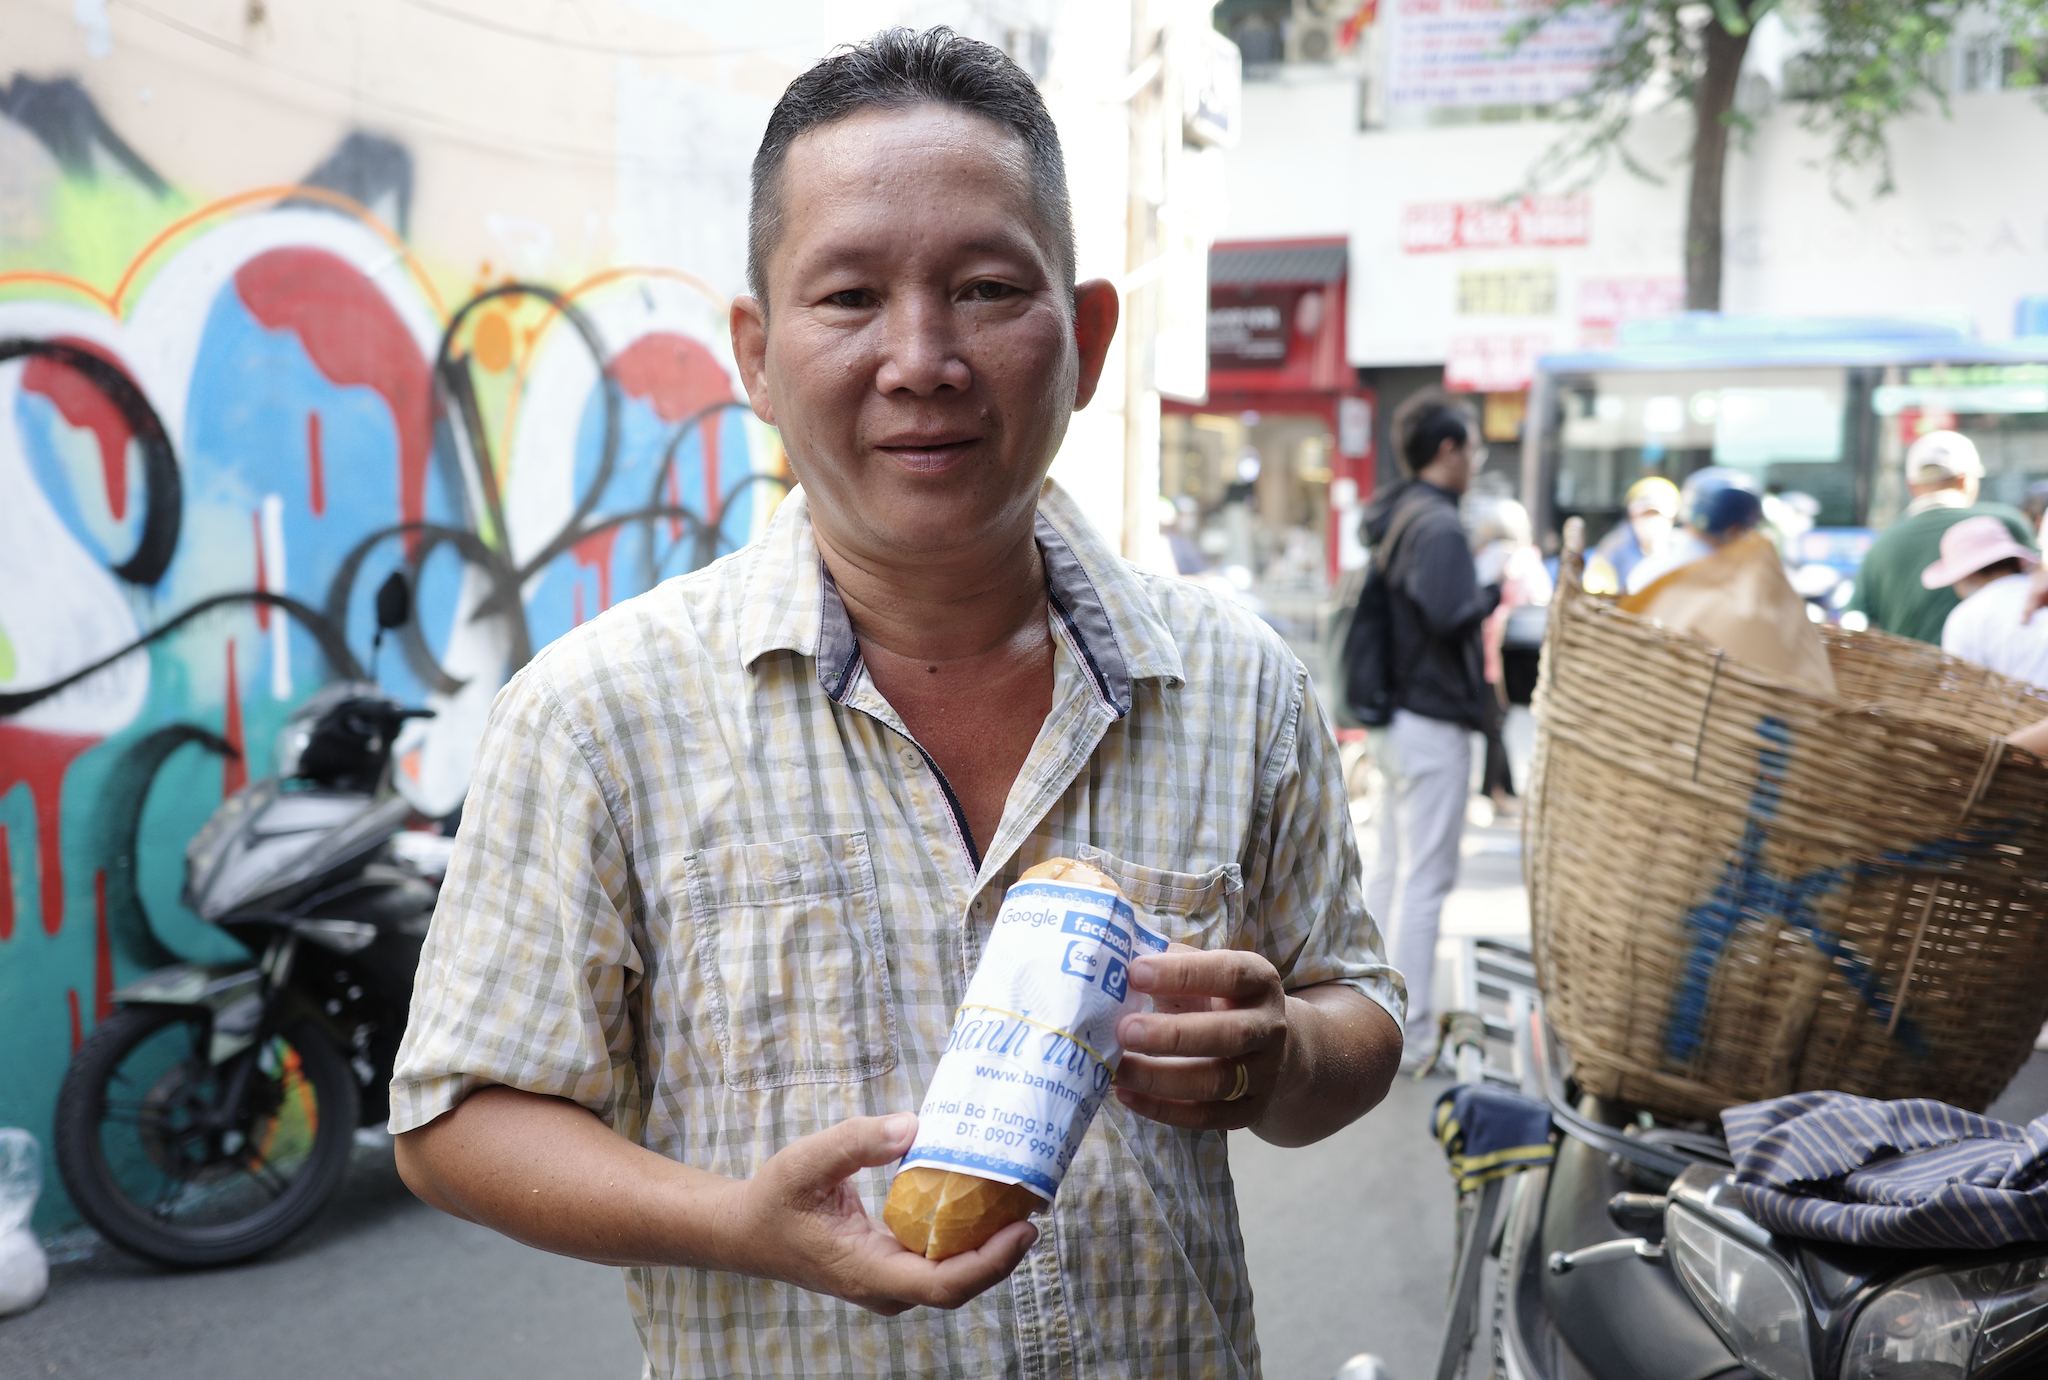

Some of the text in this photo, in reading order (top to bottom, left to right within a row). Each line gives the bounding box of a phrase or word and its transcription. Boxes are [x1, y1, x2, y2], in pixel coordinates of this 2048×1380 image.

[1002, 908, 1130, 956] Google facebook
[1075, 950, 1098, 967] Zalo
[937, 1101, 961, 1114] Hai
[964, 1103, 986, 1119] Bà
[956, 1121, 980, 1138] ĐT:
[984, 1127, 1026, 1148] 0907
[1030, 1138, 1055, 1160] 999
